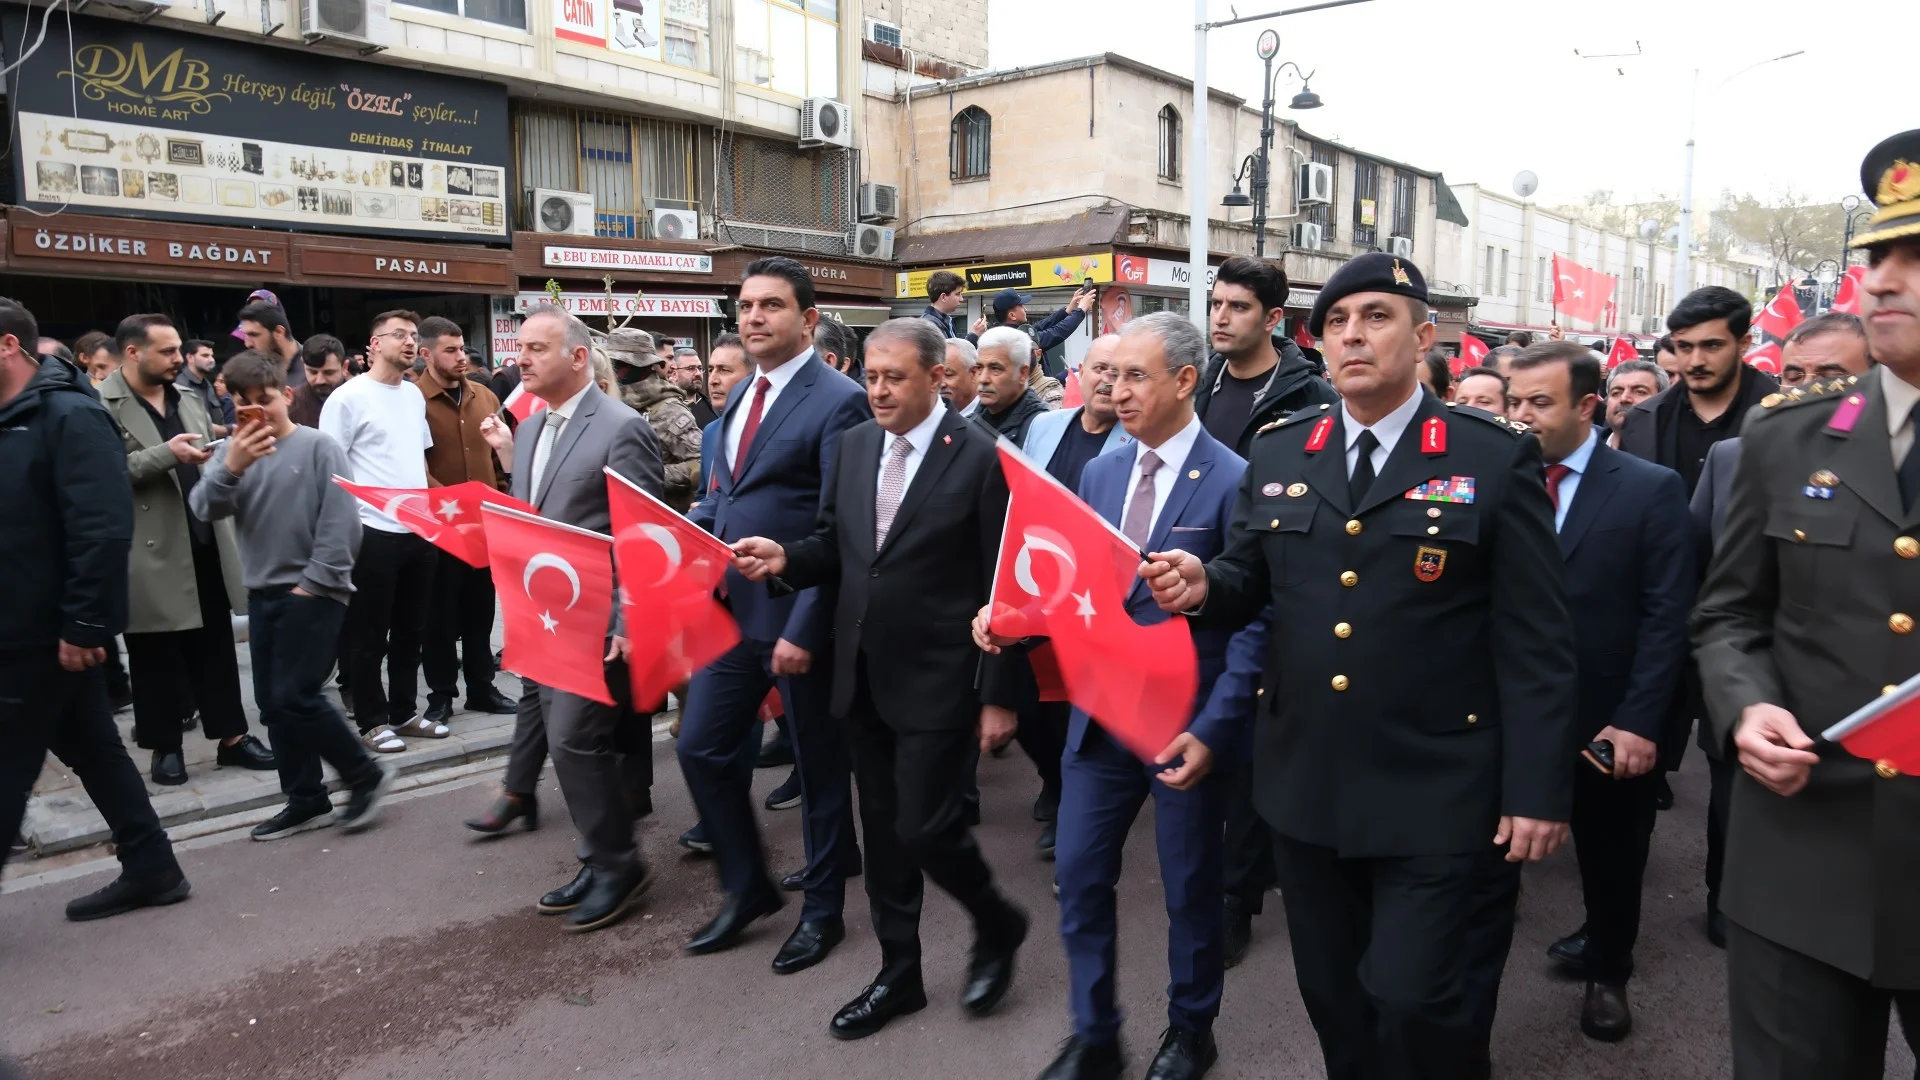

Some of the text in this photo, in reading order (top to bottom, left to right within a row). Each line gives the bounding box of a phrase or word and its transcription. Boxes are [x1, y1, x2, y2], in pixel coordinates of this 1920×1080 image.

[70, 42, 213, 98] DMB
[222, 74, 286, 105] Herşey
[291, 82, 336, 110] değil,
[108, 101, 191, 121] HOME ART
[350, 132, 473, 156] DEMİRBAŞ İTHALAT
[35, 228, 271, 264] ÖZDİKER BAĞDAT
[375, 257, 447, 275] PASAJI
[563, 251, 696, 270] EBU EMİR DAMAKLI ÇAY
[982, 271, 1027, 282] Western Union
[1127, 269, 1144, 281] UPT
[661, 299, 710, 313] BAYİSİ
[495, 319, 517, 333] EBU
